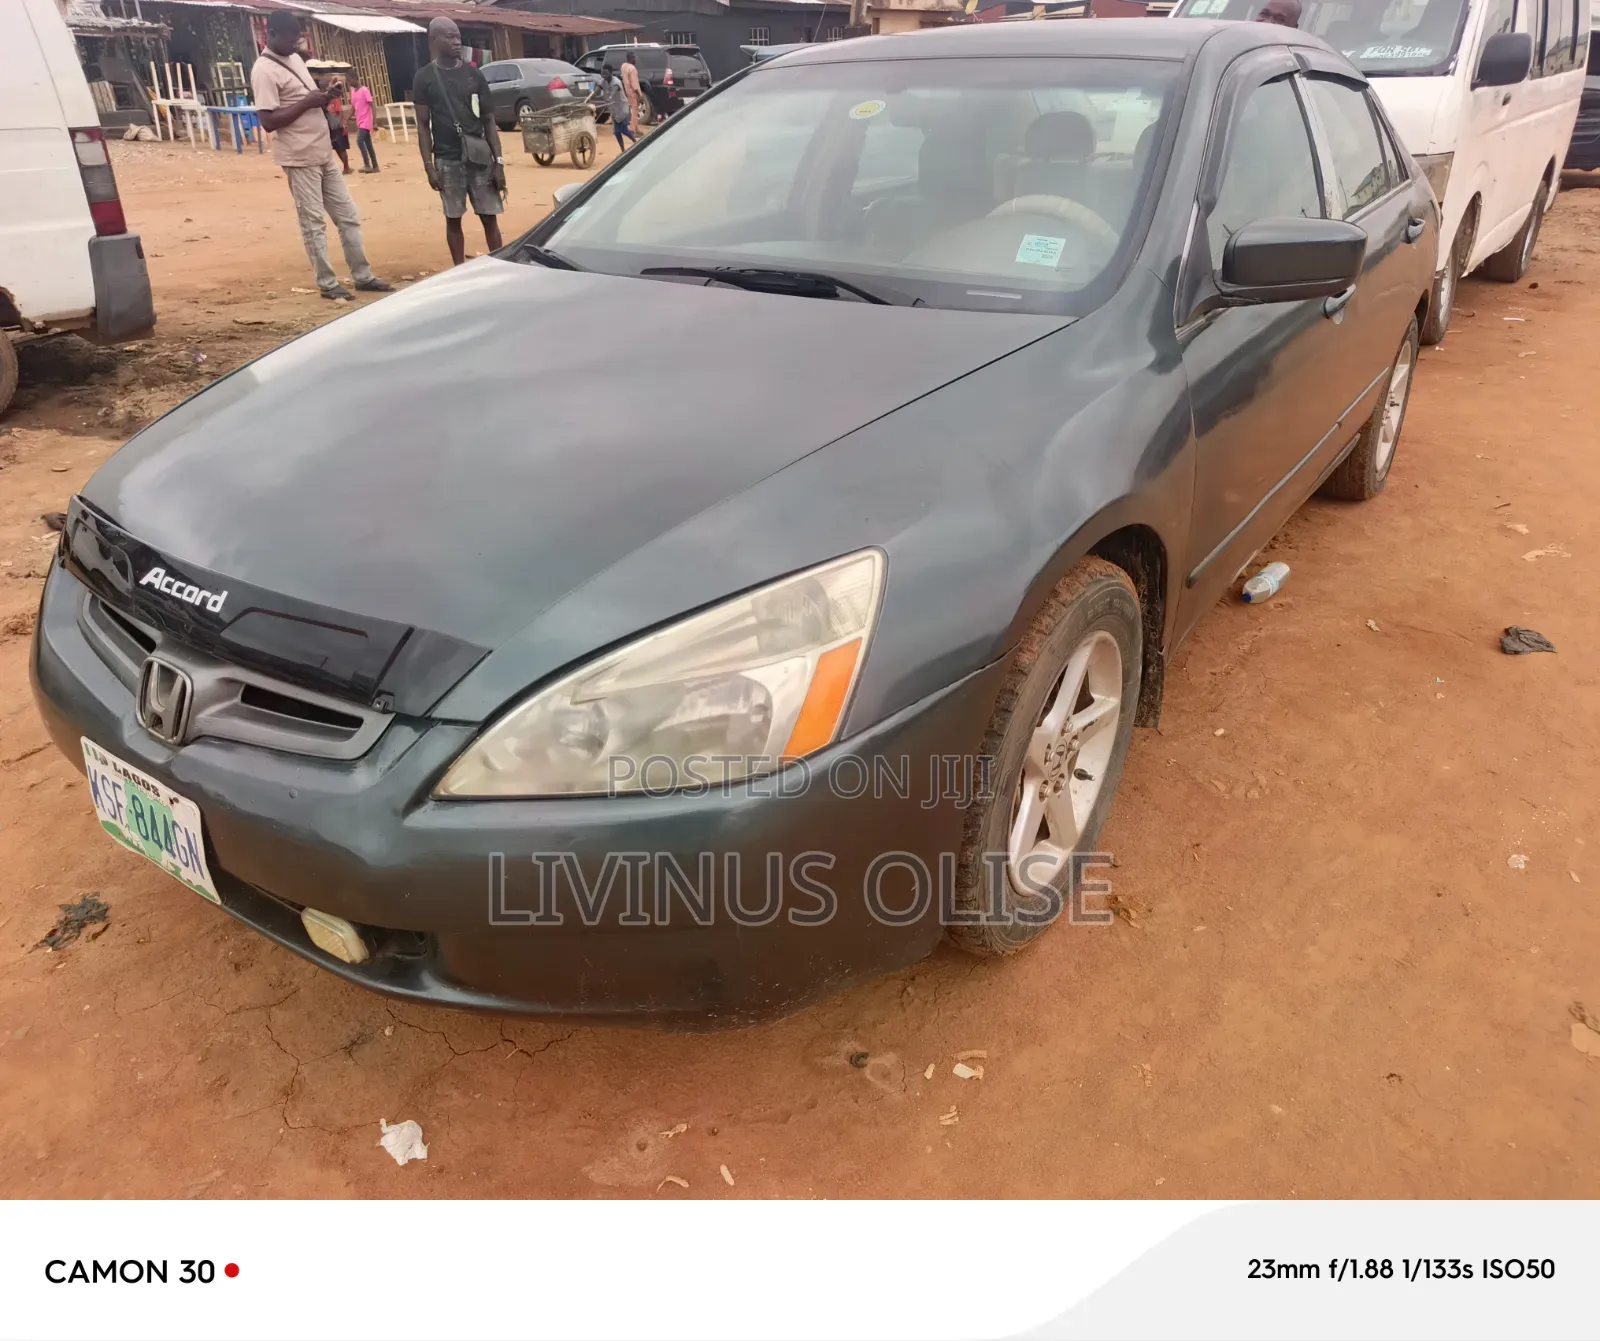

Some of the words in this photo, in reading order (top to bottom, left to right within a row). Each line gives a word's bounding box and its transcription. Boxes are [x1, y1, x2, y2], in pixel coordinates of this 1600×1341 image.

[1370, 45, 1397, 54] FOR
[139, 567, 228, 612] Accord
[112, 761, 160, 797] LAGOS
